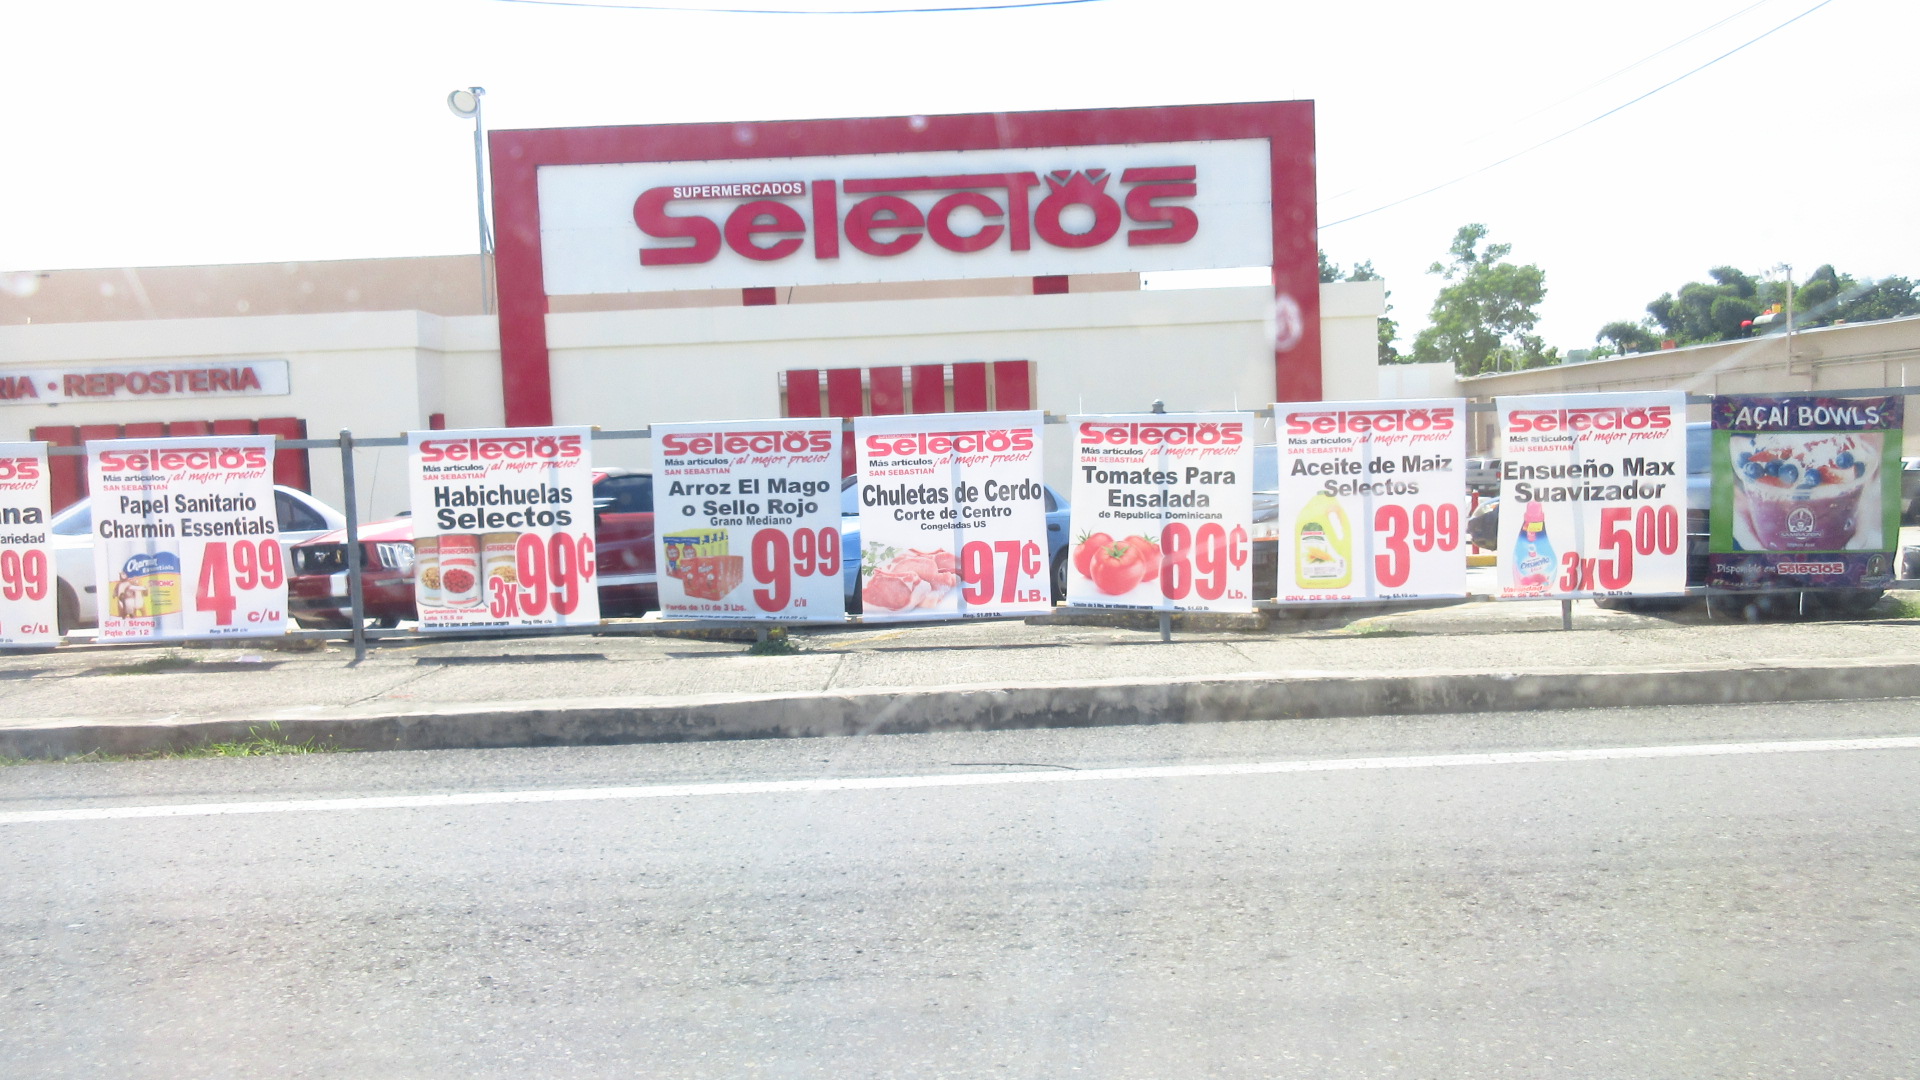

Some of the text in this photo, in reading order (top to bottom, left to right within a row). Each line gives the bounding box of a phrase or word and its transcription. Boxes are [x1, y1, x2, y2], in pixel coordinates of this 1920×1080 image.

[673, 181, 803, 199] SUPERMERCADOS
[63, 367, 262, 398] REPOSTERIA
[1735, 399, 1880, 429] AÇAÍ BOWLS
[1374, 434, 1408, 447] mejor
[1410, 430, 1451, 447] precio!
[1594, 431, 1625, 445] mejor
[1628, 429, 1669, 445] precio!
[751, 455, 786, 468] mejor
[788, 452, 830, 468] precio!
[954, 454, 989, 468] mejor
[990, 451, 1032, 468] precio!
[1165, 446, 1196, 459] mejor
[1200, 445, 1239, 459] precio!
[506, 460, 538, 473] mejor
[540, 458, 579, 472] precio!
[1290, 455, 1453, 476] Aceite de Maiz
[1503, 457, 1676, 480] Ensueño Max
[189, 471, 222, 484] mejor
[224, 469, 265, 486] precio!
[1082, 465, 1236, 485] Tomates Para
[434, 483, 573, 508] Habichuelas
[668, 478, 830, 497] Arroz El Mago
[862, 478, 1042, 507] Chuletas de Cerdo
[1324, 478, 1419, 498] Selectos
[1514, 480, 1666, 503] Suavizador
[120, 492, 257, 518] Papel Sanitario
[1108, 489, 1210, 508] Ensalada
[682, 498, 818, 518] o Sello Rojo
[894, 505, 1012, 521] Corte de Centro
[1098, 510, 1222, 520] de Republica Dominicana
[437, 506, 572, 530] Selectos
[710, 516, 792, 526] Grano Mediano
[921, 521, 972, 531] Congeladas
[100, 516, 274, 538] Charmin Essentials
[0, 533, 45, 544] ariedad
[0, 549, 48, 601] 99
[1018, 590, 1046, 603] LB.
[1228, 589, 1247, 600] Lb.
[104, 620, 155, 629] Soft Strong
[247, 609, 281, 623] c/u
[21, 622, 48, 634] c/u
